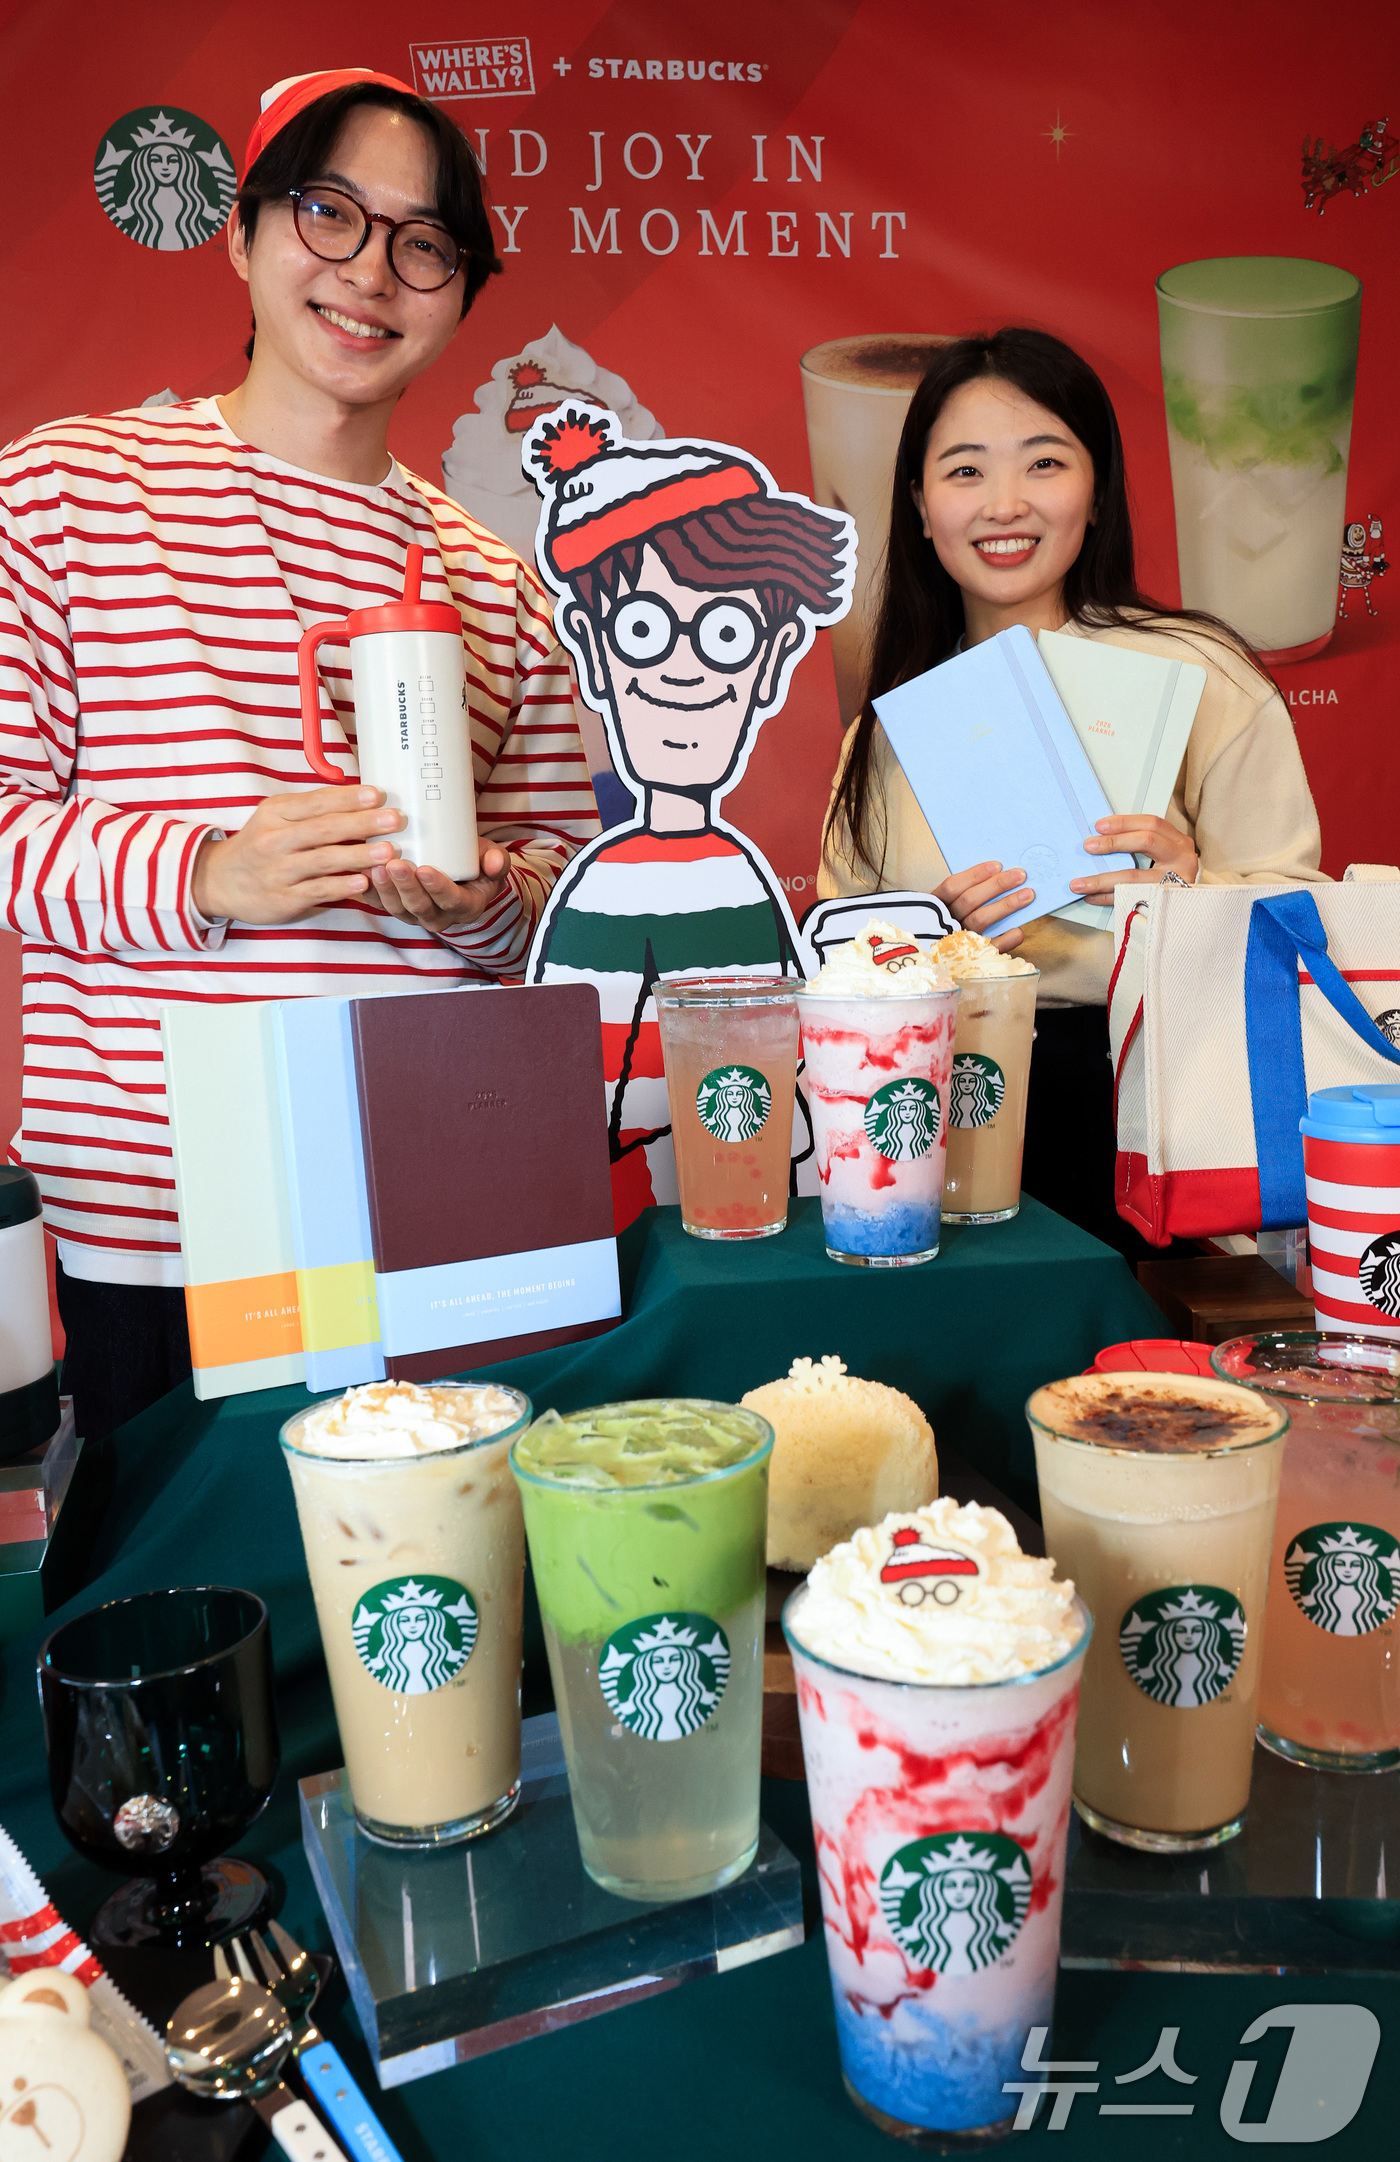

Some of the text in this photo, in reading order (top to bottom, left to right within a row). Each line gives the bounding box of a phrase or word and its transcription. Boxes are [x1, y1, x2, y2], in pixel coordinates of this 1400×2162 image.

[416, 44, 523, 70] WHERE'S
[588, 58, 763, 82] STARBUCKS
[421, 65, 524, 93] WALLY?
[585, 131, 712, 191] JOY
[751, 134, 825, 182] IN
[569, 206, 907, 259] MOMENT
[398, 681, 410, 751] STARBUCKS
[1088, 724, 1116, 737] PLANNER
[430, 1278, 576, 1310] IT'S ALL AHEAD, THE MOMENT BEGINS
[245, 1311, 261, 1321] IT'S
[264, 1308, 278, 1318] ALL
